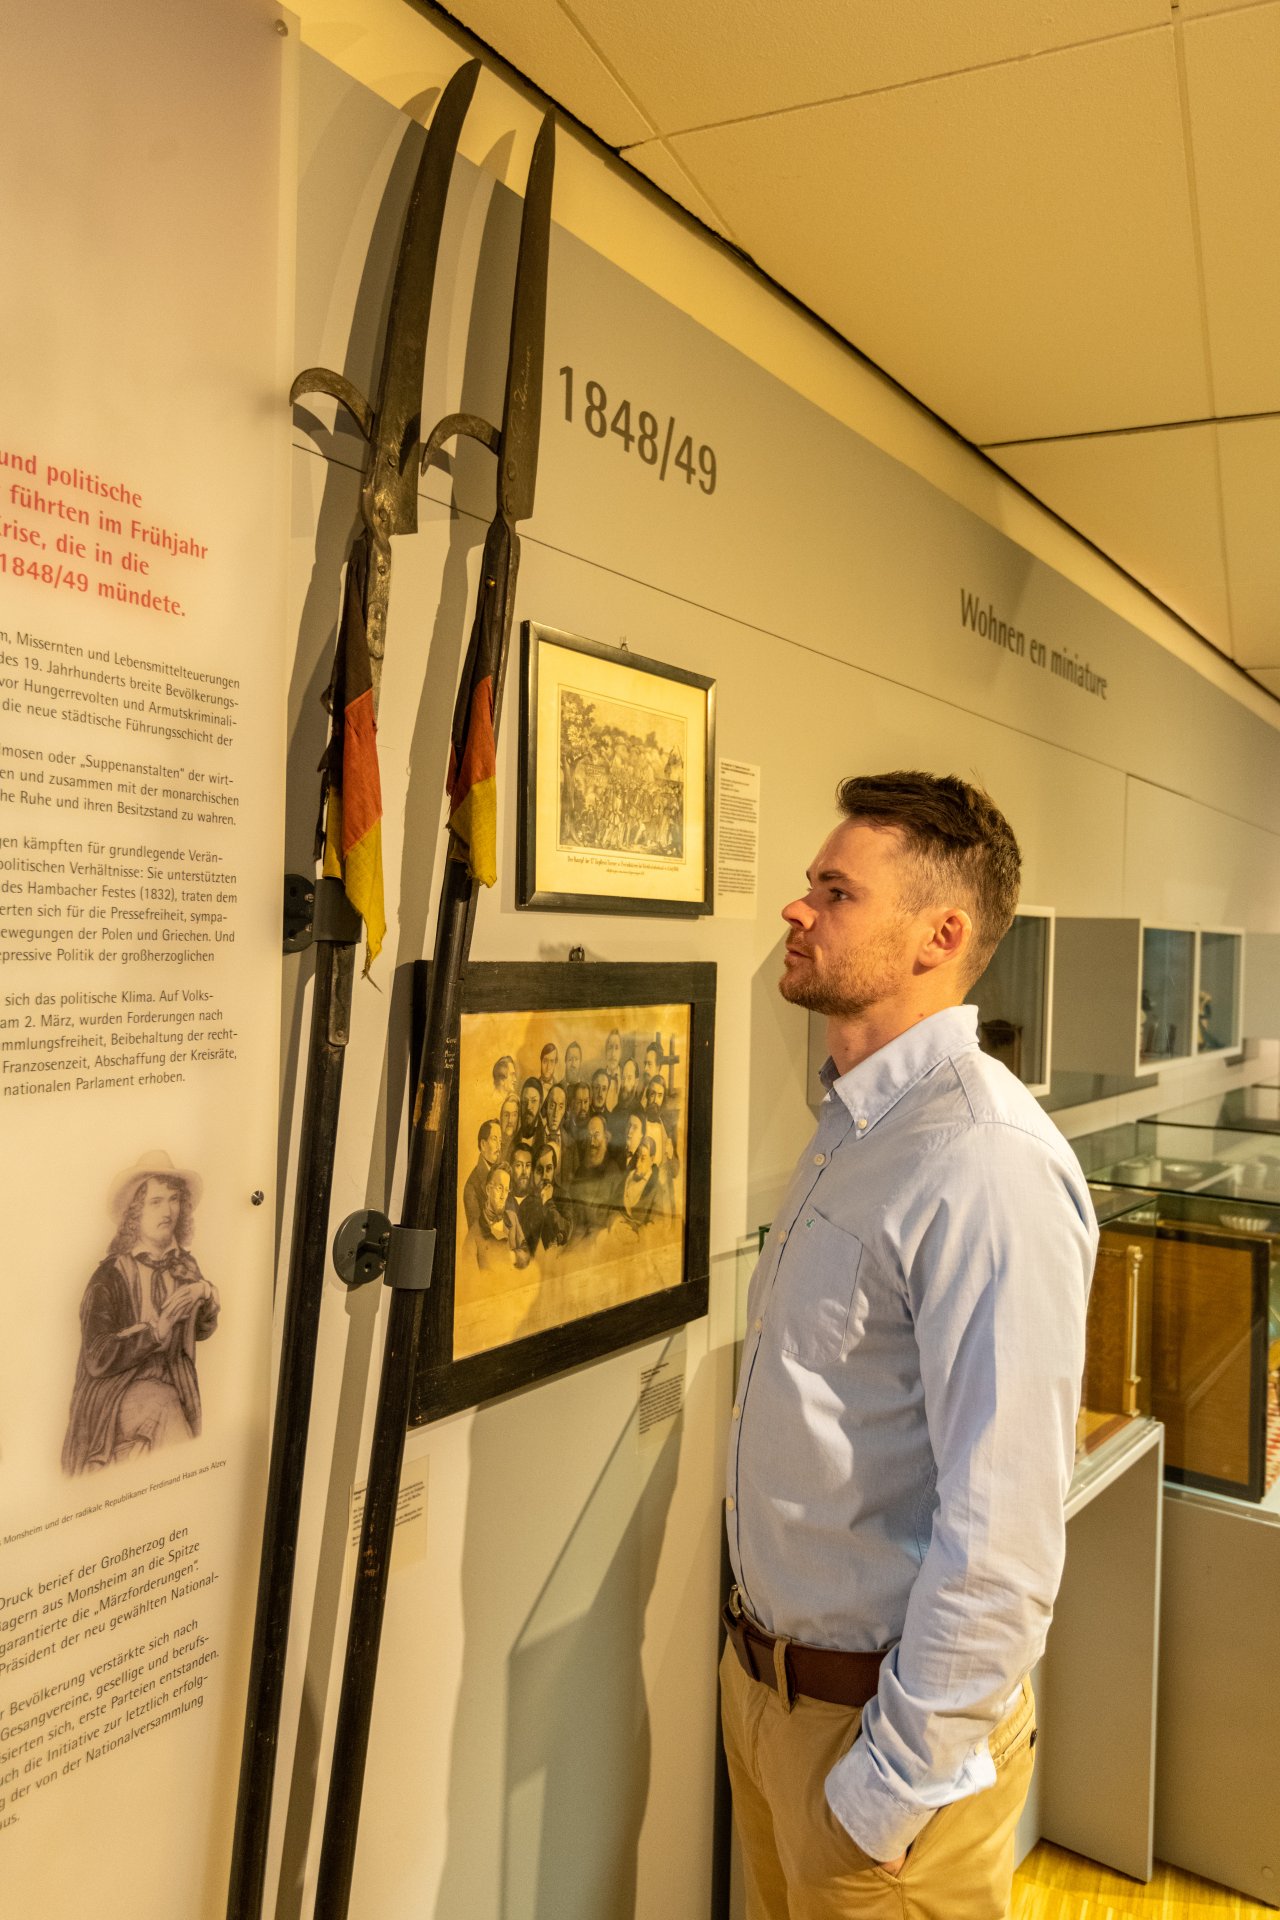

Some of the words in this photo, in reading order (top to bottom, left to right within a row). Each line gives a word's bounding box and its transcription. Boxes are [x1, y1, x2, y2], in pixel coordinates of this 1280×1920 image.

[560, 366, 716, 495] 1848/49
[0, 451, 36, 475] und
[47, 466, 142, 508] politische
[0, 516, 46, 550] rise,
[56, 534, 86, 558] die
[96, 543, 112, 565] in
[120, 552, 149, 575] die
[10, 484, 89, 525] führten
[99, 510, 122, 535] im
[131, 520, 208, 559] Frühjahr
[0, 553, 88, 592] 1848/49
[98, 582, 185, 616] mündete.
[17, 632, 83, 657] Missernten
[88, 650, 110, 662] und
[114, 652, 240, 689] Lebensmittelteuerungen
[961, 588, 1025, 657] Wohnen
[1030, 638, 1046, 668] en
[1051, 647, 1108, 700] miniature
[0, 651, 18, 666] des
[24, 657, 42, 671] 19.
[46, 660, 126, 687] Jahrhunderts
[130, 676, 161, 694] breite
[166, 683, 238, 709] Bevölkerungs-
[0, 678, 19, 689] vor
[24, 678, 118, 707] Hungerrevolten
[124, 700, 144, 711] und
[148, 702, 237, 726] Armutskriminali-
[2, 698, 21, 713] die
[27, 705, 57, 718] neue
[62, 710, 121, 728] städtische
[126, 718, 213, 744] Führungsschicht
[217, 734, 233, 746] der
[20, 771, 44, 783] und
[48, 775, 112, 791] zusammen
[118, 782, 136, 794] mit
[140, 784, 158, 796] der
[162, 789, 239, 806] monarchischen
[48, 752, 76, 764] oder
[188, 770, 205, 782] der
[209, 773, 234, 785] wirt-
[20, 790, 52, 806] Ruhe
[56, 797, 79, 809] und
[84, 798, 112, 812] ihren
[118, 801, 178, 819] Besitzstand
[182, 812, 193, 820] zu
[198, 812, 236, 826] wahren.
[24, 836, 82, 854] kämpften
[88, 841, 105, 854] für
[110, 846, 185, 862] grundlegende
[189, 849, 223, 862] Verän-
[70, 861, 143, 878] Verhältnisse:
[148, 867, 163, 879] Sie
[168, 870, 236, 884] unterstützten
[1, 880, 23, 893] des
[28, 881, 98, 896] Hambacher
[102, 885, 136, 898] Festes
[140, 886, 177, 902] (1832),
[182, 891, 212, 902] traten
[216, 891, 237, 903] dem
[37, 904, 61, 917] sich
[66, 905, 84, 917] für
[89, 906, 106, 918] die
[111, 906, 186, 922] Pressefreiheit,
[190, 913, 227, 924] sympa-
[57, 948, 94, 961] Politik
[98, 949, 117, 961] der
[122, 949, 214, 964] großherzoglichen
[78, 928, 97, 940] der
[102, 928, 132, 940] Polen
[137, 929, 158, 940] und
[162, 929, 211, 941] Griechen.
[215, 930, 234, 942] Und
[0, 1019, 19, 1029] am
[25, 1016, 36, 1028] 2.
[41, 1014, 74, 1028] März,
[80, 1012, 122, 1025] wurden
[127, 1011, 194, 1025] Forderungen
[199, 1009, 222, 1020] nach
[5, 993, 30, 1006] sich
[35, 993, 56, 1005] das
[60, 992, 117, 1008] politische
[122, 991, 155, 1002] Klima.
[159, 990, 180, 1002] Auf
[182, 990, 214, 1001] Volks-
[3, 1056, 90, 1073] Franzosenzeit,
[94, 1052, 166, 1067] Abschaffung
[170, 1051, 187, 1062] der
[191, 1048, 236, 1060] Kreisräte,
[111, 1032, 183, 1045] Beibehaltung
[187, 1030, 204, 1041] der
[208, 1028, 238, 1040] recht-
[4, 1080, 70, 1096] nationalen
[76, 1076, 134, 1090] Parlament
[138, 1072, 185, 1085] erhoben.
[4, 1526, 42, 1544] Monsheim
[45, 1518, 59, 1530] und
[62, 1515, 73, 1523] der
[76, 1504, 102, 1518] radikale
[105, 1488, 148, 1508] Republikaner
[150, 1475, 180, 1492] Ferdinand
[182, 1470, 197, 1480] Haas
[199, 1466, 209, 1474] aus
[38, 1569, 74, 1594] berief
[78, 1564, 97, 1578] der
[101, 1537, 165, 1568] Großherzog
[169, 1528, 188, 1542] den
[42, 1598, 63, 1614] aus
[68, 1572, 126, 1604] Monsheim
[131, 1565, 144, 1578] an
[148, 1556, 164, 1570] die
[168, 1543, 200, 1563] Spitze
[0, 1642, 56, 1676] Präsident
[61, 1634, 80, 1649] der
[84, 1622, 105, 1639] neu
[110, 1596, 166, 1631] gewählten
[172, 1572, 219, 1600] National-
[0, 1618, 68, 1658] garantierte
[72, 1608, 89, 1622] die
[0, 1692, 91, 1741] Gesangvereine,
[96, 1666, 144, 1699] gesellige
[148, 1651, 168, 1670] und
[172, 1636, 209, 1658] berufs-
[10, 1674, 85, 1716] Bevölkerung
[90, 1646, 145, 1677] verstärkte
[148, 1633, 169, 1650] sich
[174, 1619, 198, 1639] nach
[48, 1720, 74, 1740] sich,
[79, 1705, 106, 1724] erste
[111, 1680, 155, 1709] Parteien
[160, 1650, 219, 1684] entstanden.
[11, 1784, 31, 1802] der
[36, 1771, 57, 1788] von
[62, 1758, 81, 1775] der
[86, 1696, 203, 1763] Nationalversammlung
[24, 1758, 42, 1774] die
[48, 1729, 100, 1762] Initiative
[104, 1717, 122, 1733] zur
[126, 1692, 168, 1722] letztlich
[173, 1676, 208, 1697] erfolg-
